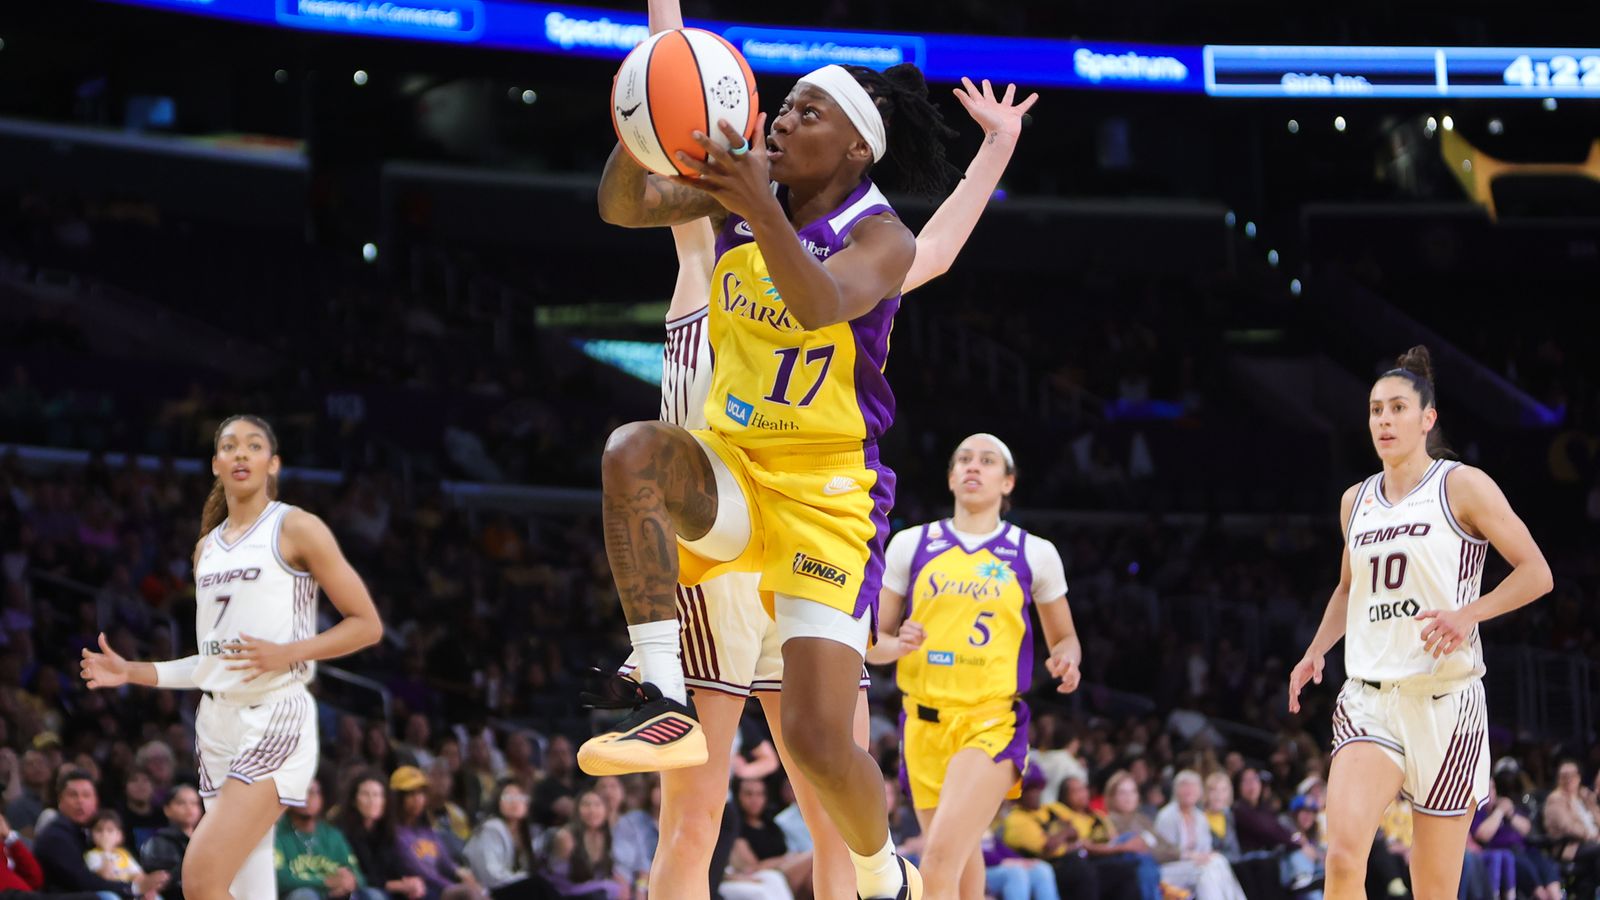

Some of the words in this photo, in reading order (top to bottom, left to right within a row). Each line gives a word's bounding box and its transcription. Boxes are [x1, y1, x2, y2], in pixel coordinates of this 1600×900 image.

[1073, 48, 1178, 83] Spectrum
[1503, 54, 1600, 89] 4:22
[801, 238, 831, 257] Albert
[763, 343, 836, 408] 17
[726, 399, 748, 422] UCLA
[751, 411, 800, 431] Health
[830, 475, 855, 489] NIKE
[1353, 523, 1432, 549] TEMPO
[198, 567, 262, 588] TEMPO
[801, 559, 847, 586] WNBA
[1369, 551, 1408, 594] 10
[214, 595, 232, 630] 7
[1368, 600, 1402, 622] CIBC
[967, 610, 995, 647] 5
[928, 653, 953, 664] UCLA
